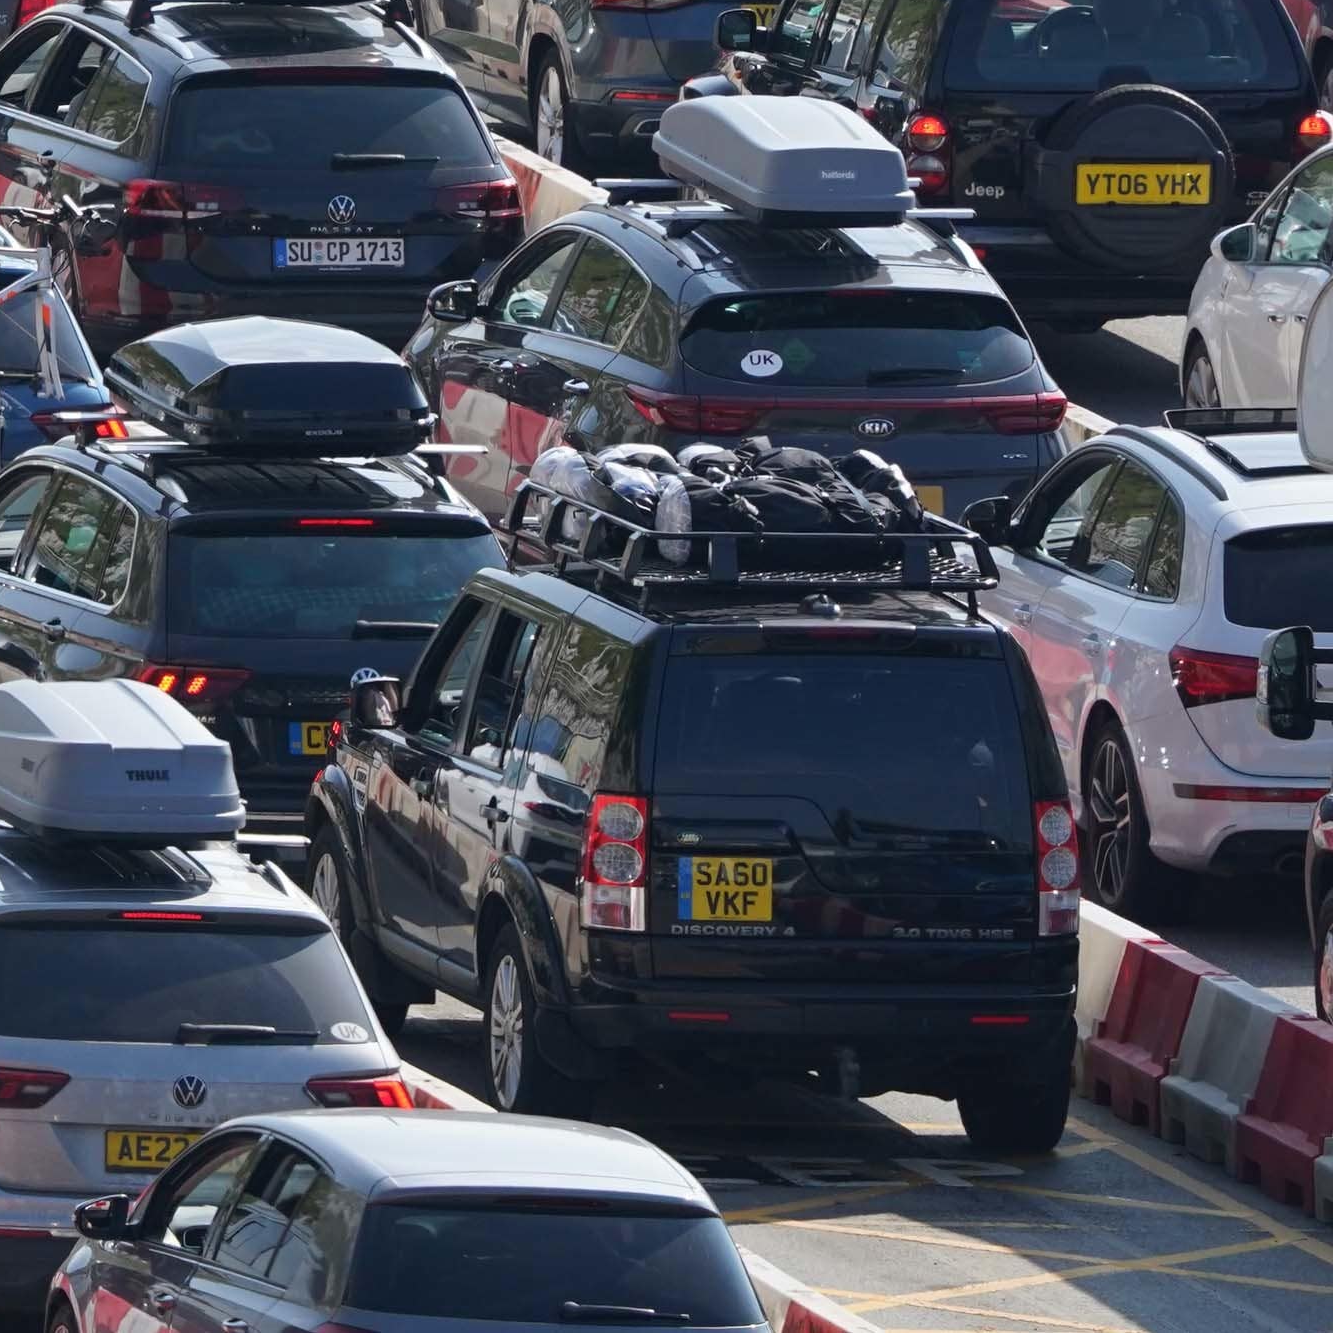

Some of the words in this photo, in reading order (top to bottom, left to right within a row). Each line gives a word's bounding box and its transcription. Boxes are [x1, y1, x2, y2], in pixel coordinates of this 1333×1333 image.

[964, 182, 1006, 199] Jeep
[1087, 173, 1148, 195] YT06
[1156, 173, 1204, 196] YHX
[288, 241, 313, 263] SU
[327, 241, 351, 263] CP
[356, 240, 404, 264] 1713
[749, 354, 776, 367] UK
[865, 420, 889, 432] KIA
[125, 769, 170, 782] THULE
[695, 862, 768, 888] SA60
[706, 891, 757, 917] VKF
[670, 924, 773, 937] DISCOVERY
[782, 925, 796, 937] 4
[978, 928, 1015, 940] HSE
[338, 1025, 361, 1040] UK
[118, 1135, 190, 1162] AE22
